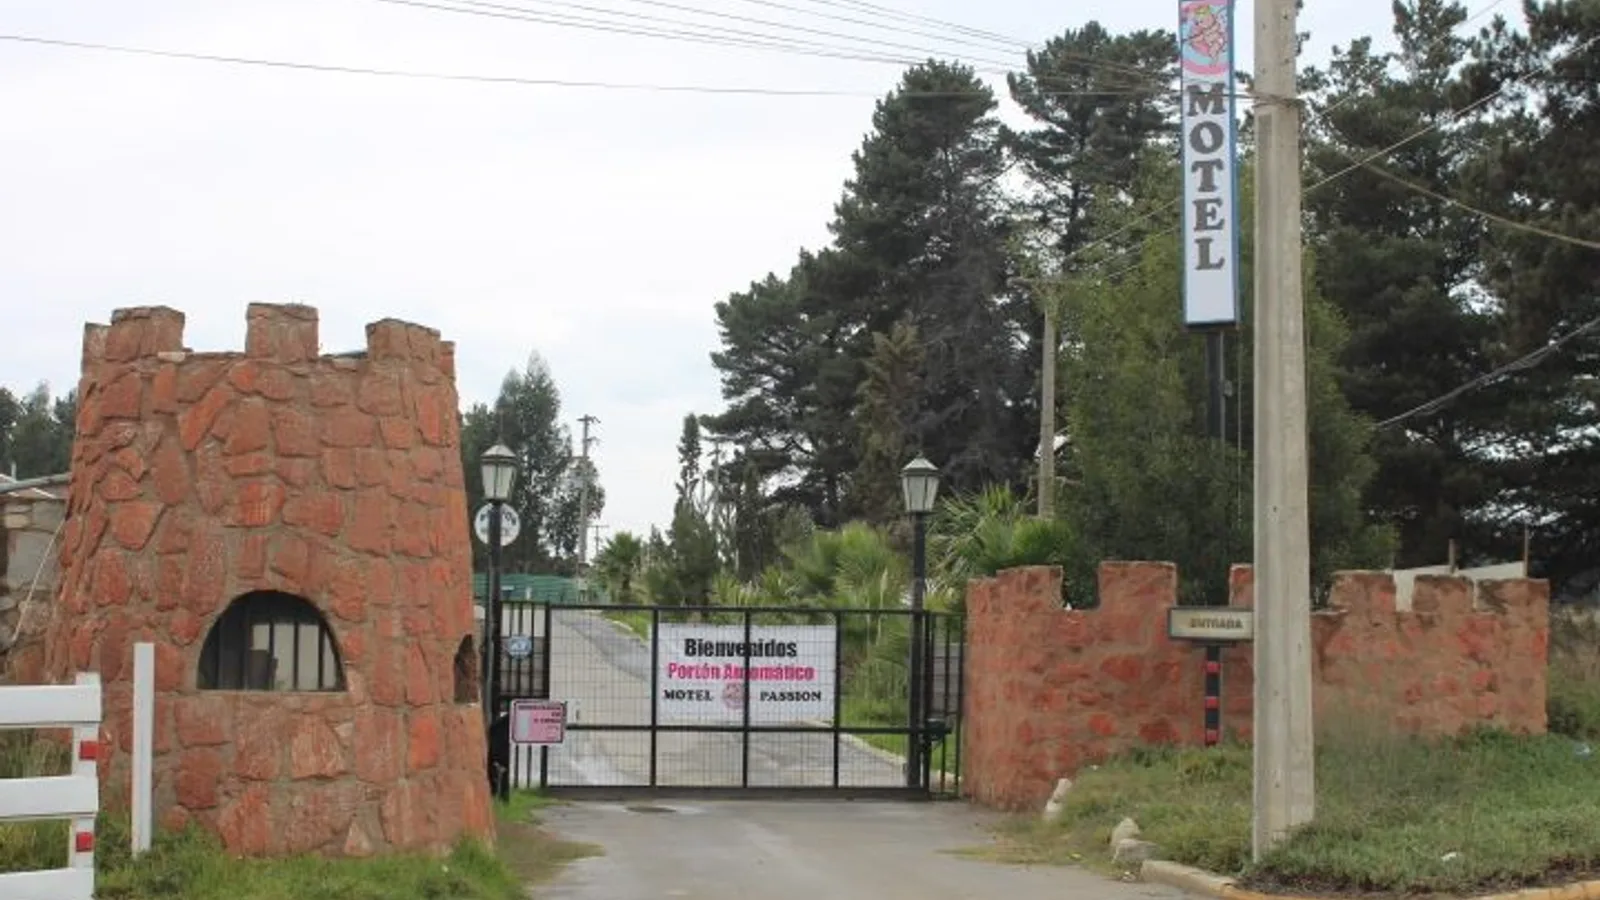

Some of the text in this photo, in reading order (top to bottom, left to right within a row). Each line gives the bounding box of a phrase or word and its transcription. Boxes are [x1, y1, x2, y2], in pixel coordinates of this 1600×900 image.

[1186, 82, 1227, 271] MOTEL
[684, 638, 798, 657] Bienvenidos
[668, 662, 815, 681] Portón Auomático
[664, 689, 822, 702] MOTEL PASSION
